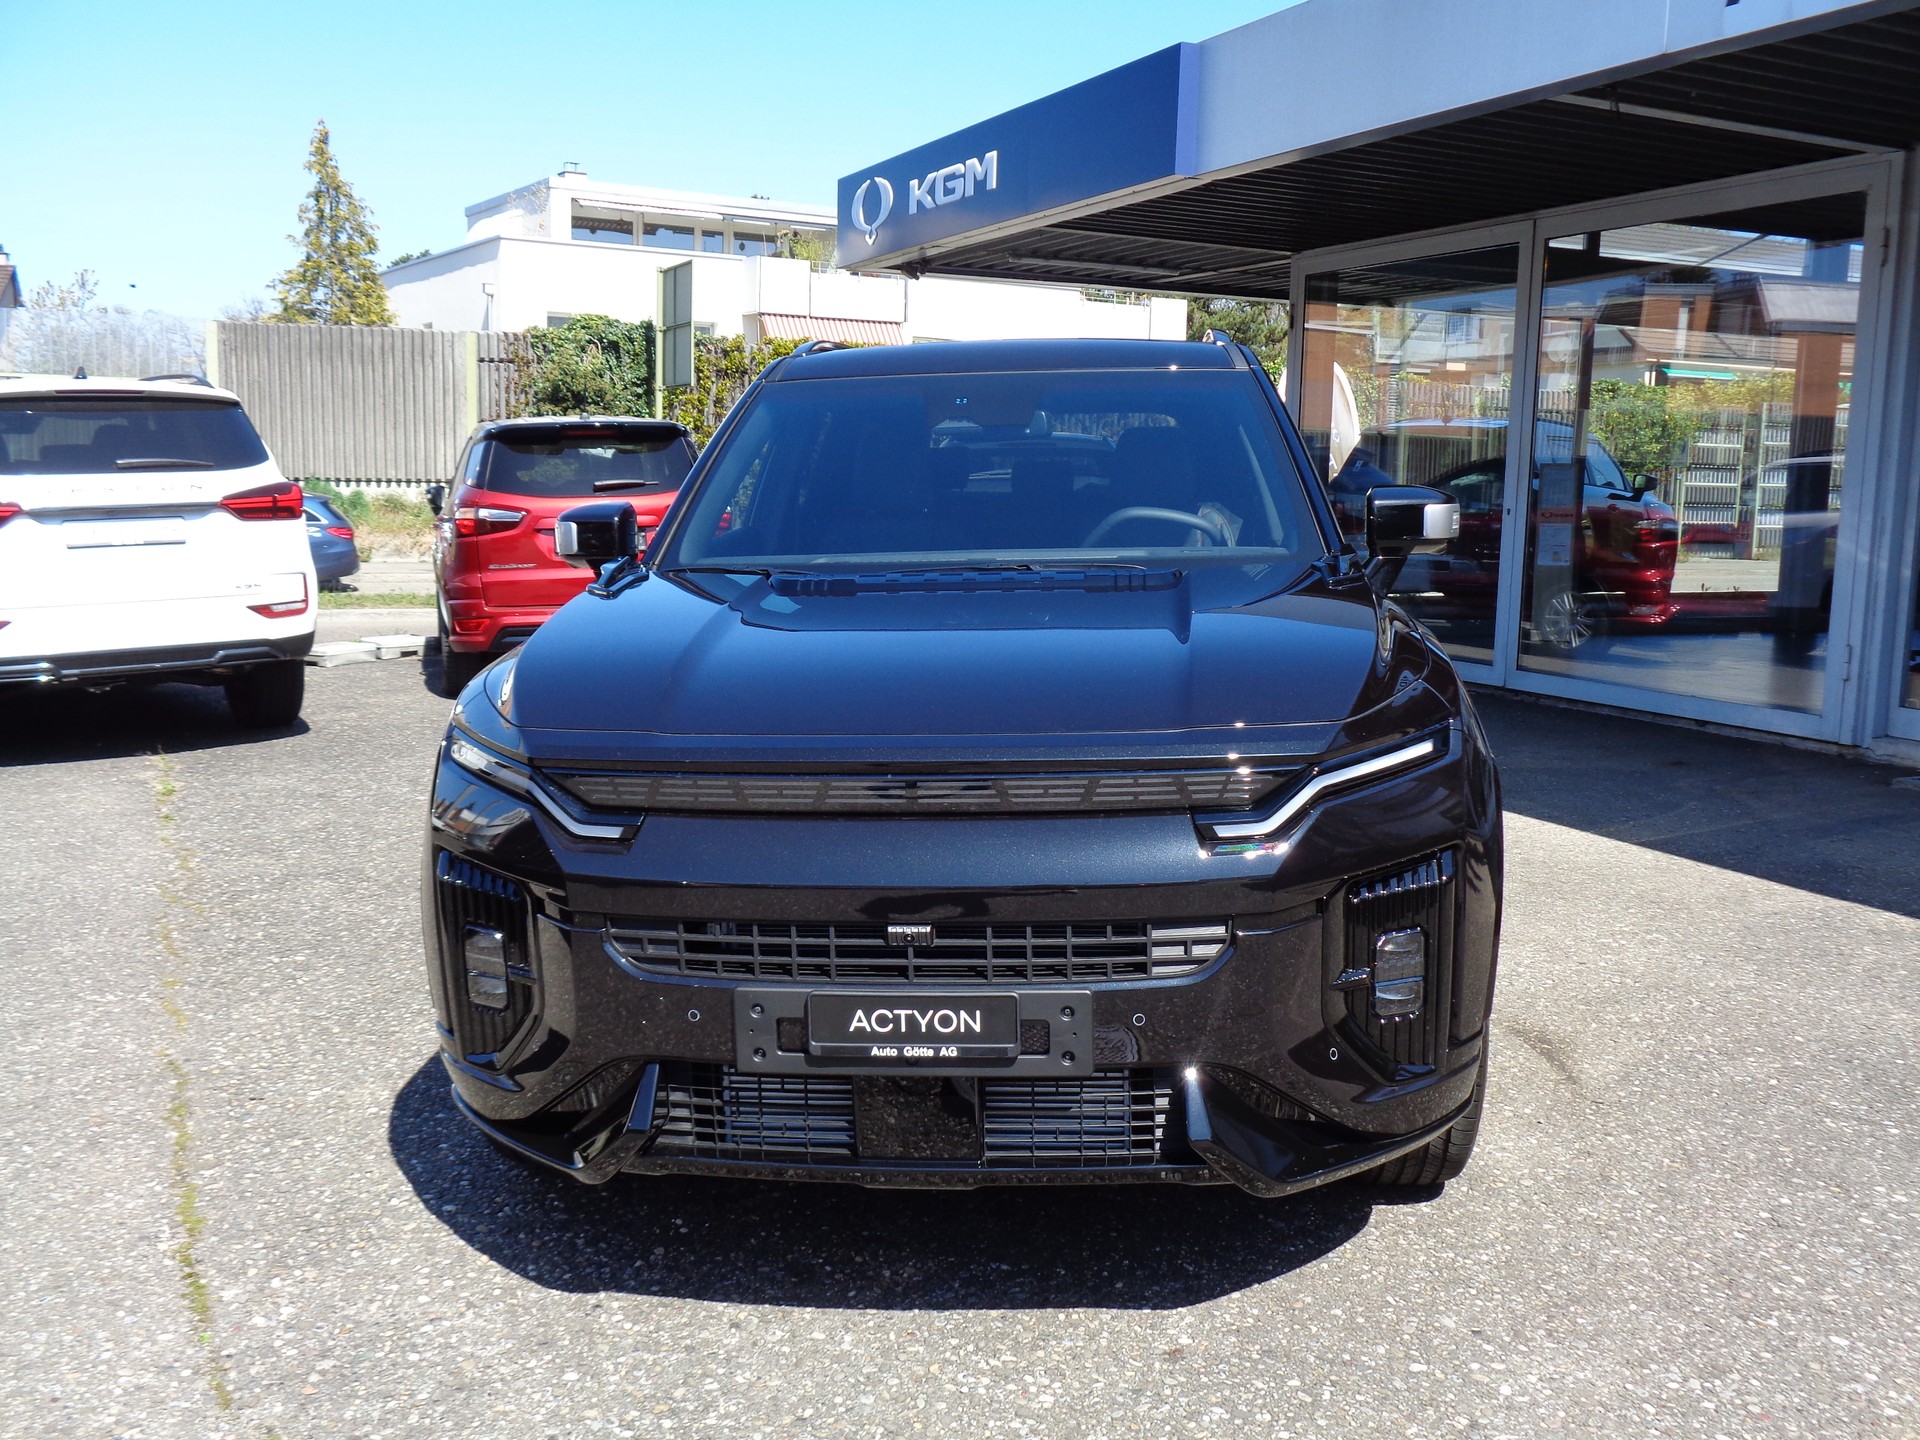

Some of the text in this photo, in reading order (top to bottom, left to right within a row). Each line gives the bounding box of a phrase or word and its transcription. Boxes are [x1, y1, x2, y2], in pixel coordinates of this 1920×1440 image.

[908, 150, 998, 215] KGM
[848, 1009, 981, 1033] ACTYON
[870, 1046, 957, 1057] Auto Götte AG
